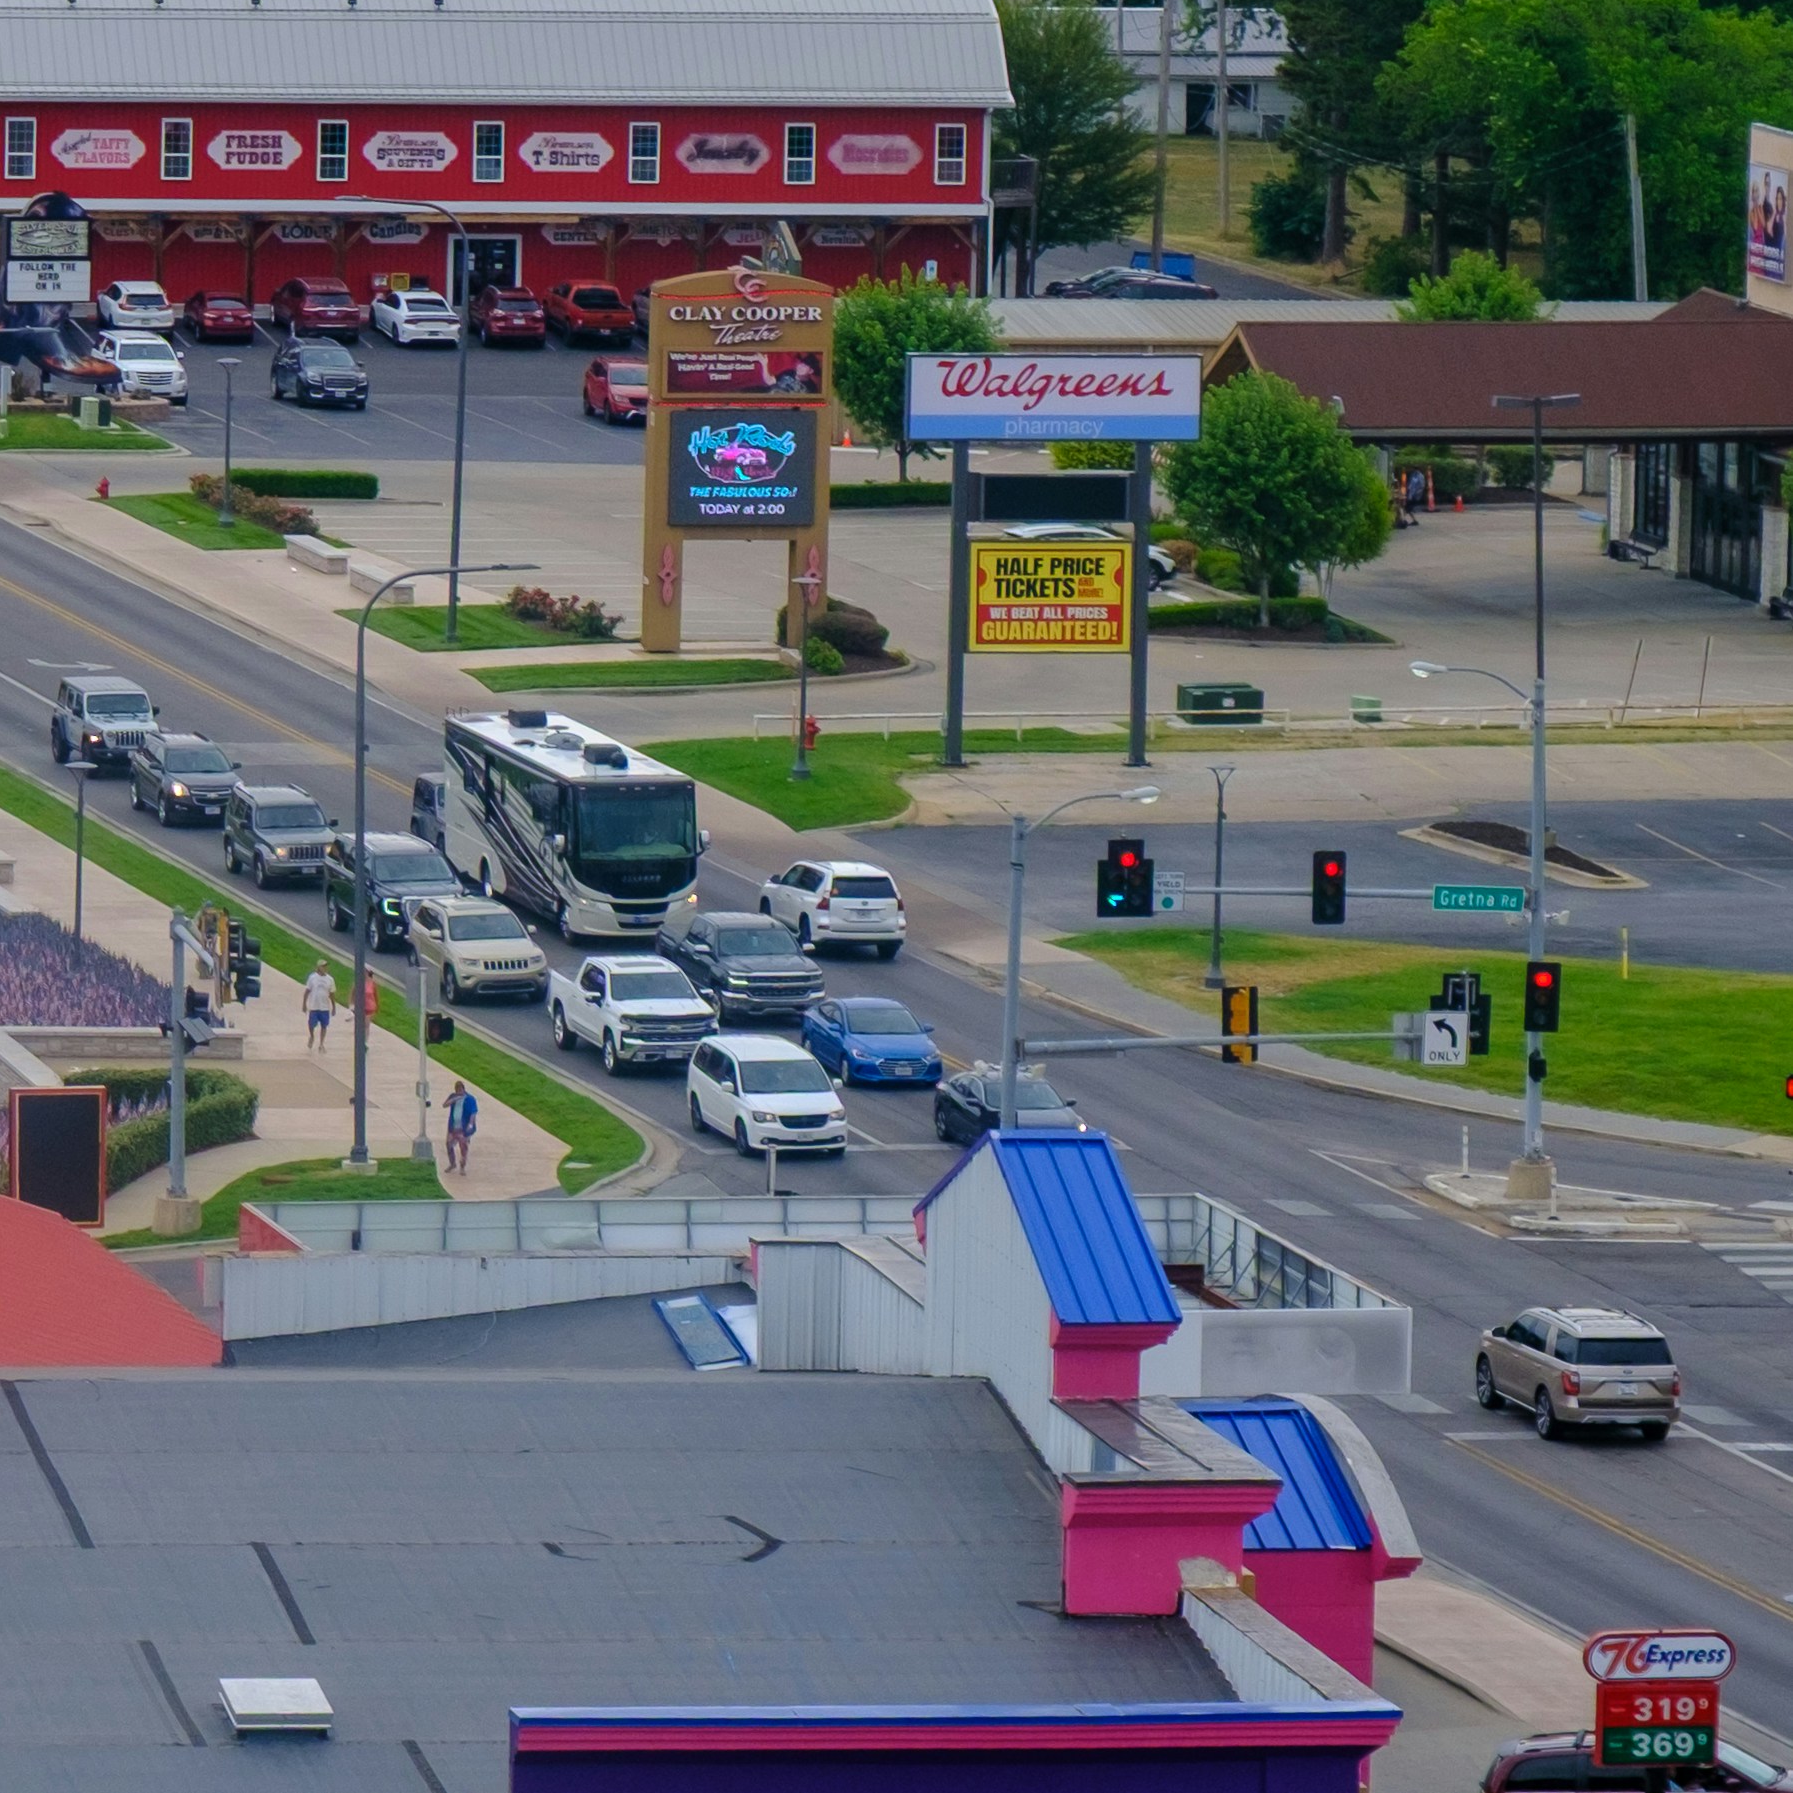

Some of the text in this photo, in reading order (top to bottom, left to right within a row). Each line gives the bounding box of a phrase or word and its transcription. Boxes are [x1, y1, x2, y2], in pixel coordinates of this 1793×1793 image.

[92, 137, 130, 150] TAFFY
[224, 134, 283, 150] FRESH
[73, 151, 131, 164] FLAVORS
[224, 151, 283, 166] FUDGE
[376, 147, 446, 161] SOUVENIRS
[532, 150, 600, 167] T-Shirts
[396, 159, 434, 168] GIFTS
[19, 262, 76, 271] FOLLOW THE
[669, 306, 823, 321] CLAY COOPER
[709, 323, 783, 346] Theatre
[936, 357, 1175, 411] Walgreens
[1004, 417, 1104, 439] pharmacy
[688, 422, 797, 457] Hot Rods
[690, 486, 712, 497] THE
[712, 486, 772, 497] FABULOUS
[699, 504, 785, 515] TODAY at 2:00
[995, 557, 1105, 576] HALF PRICE
[994, 577, 1075, 598] TICKETS
[989, 606, 1108, 620] WE BEAT ALL PRICES
[981, 620, 1118, 641] GUARANTEED!
[1157, 880, 1181, 888] YIELD
[1439, 889, 1520, 908] Gretna Rd
[1428, 1049, 1461, 1062] ONLY
[1599, 1635, 1728, 1678] 76 Express
[1633, 1697, 1696, 1721] 319
[1632, 1731, 1695, 1757] 369
